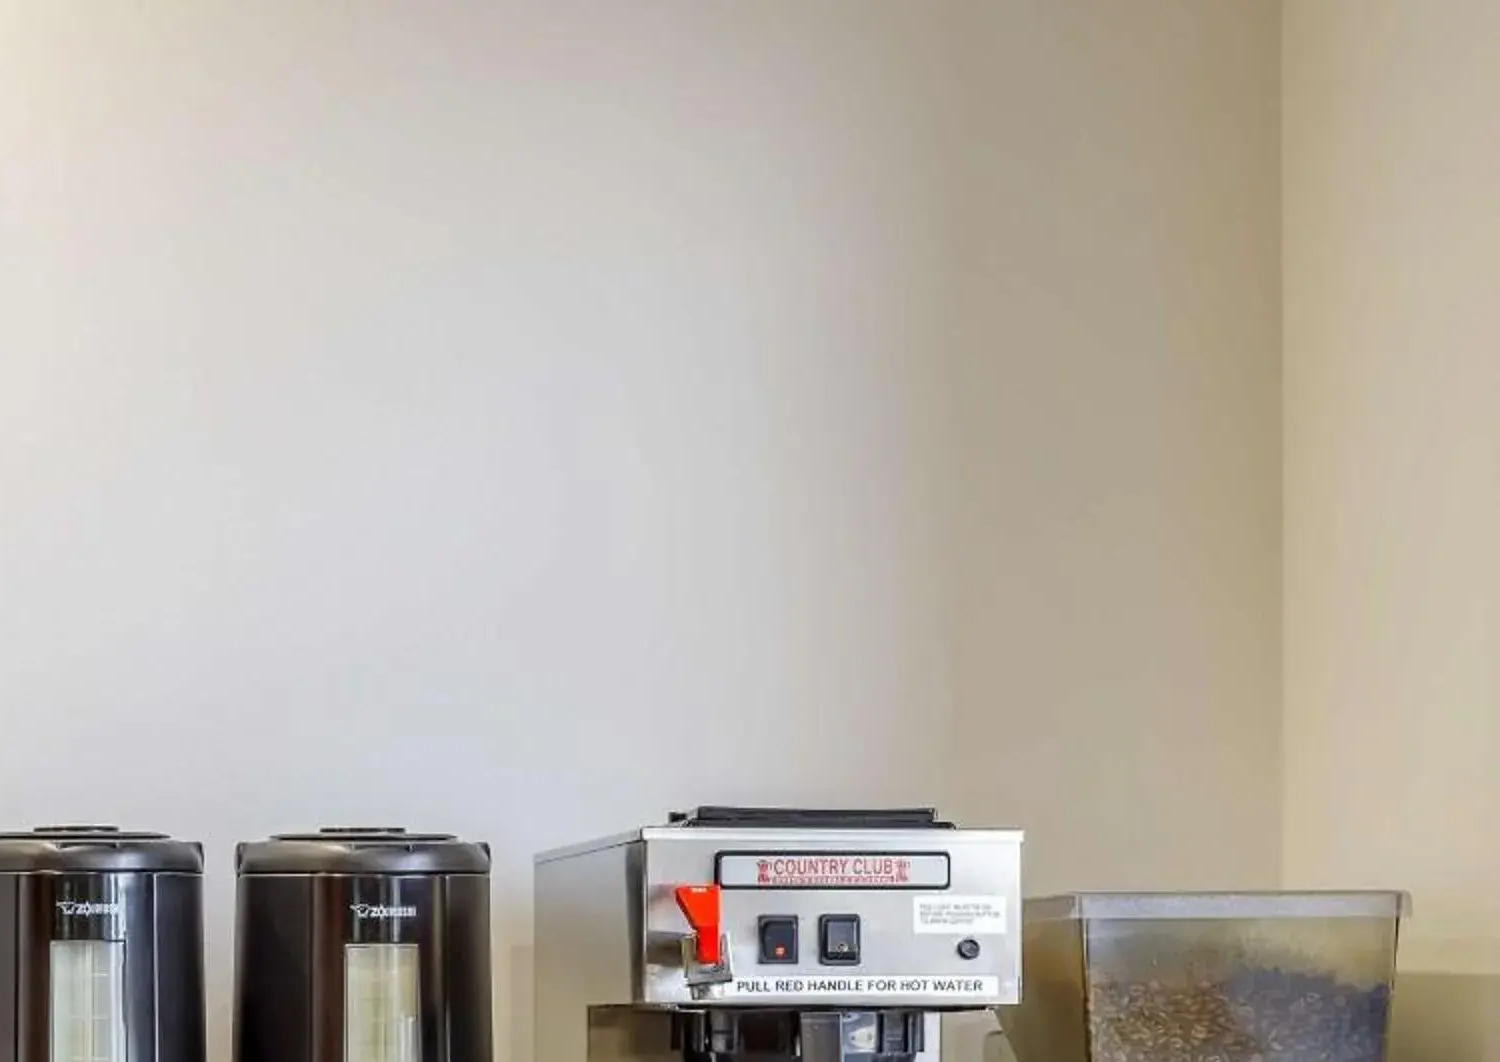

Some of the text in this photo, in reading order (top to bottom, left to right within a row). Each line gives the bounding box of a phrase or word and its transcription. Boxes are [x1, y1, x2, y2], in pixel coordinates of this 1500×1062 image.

[773, 858, 894, 876] COUNTRY CLUB
[736, 980, 983, 992] PULL RED HANDLE FOR HOT WATER
